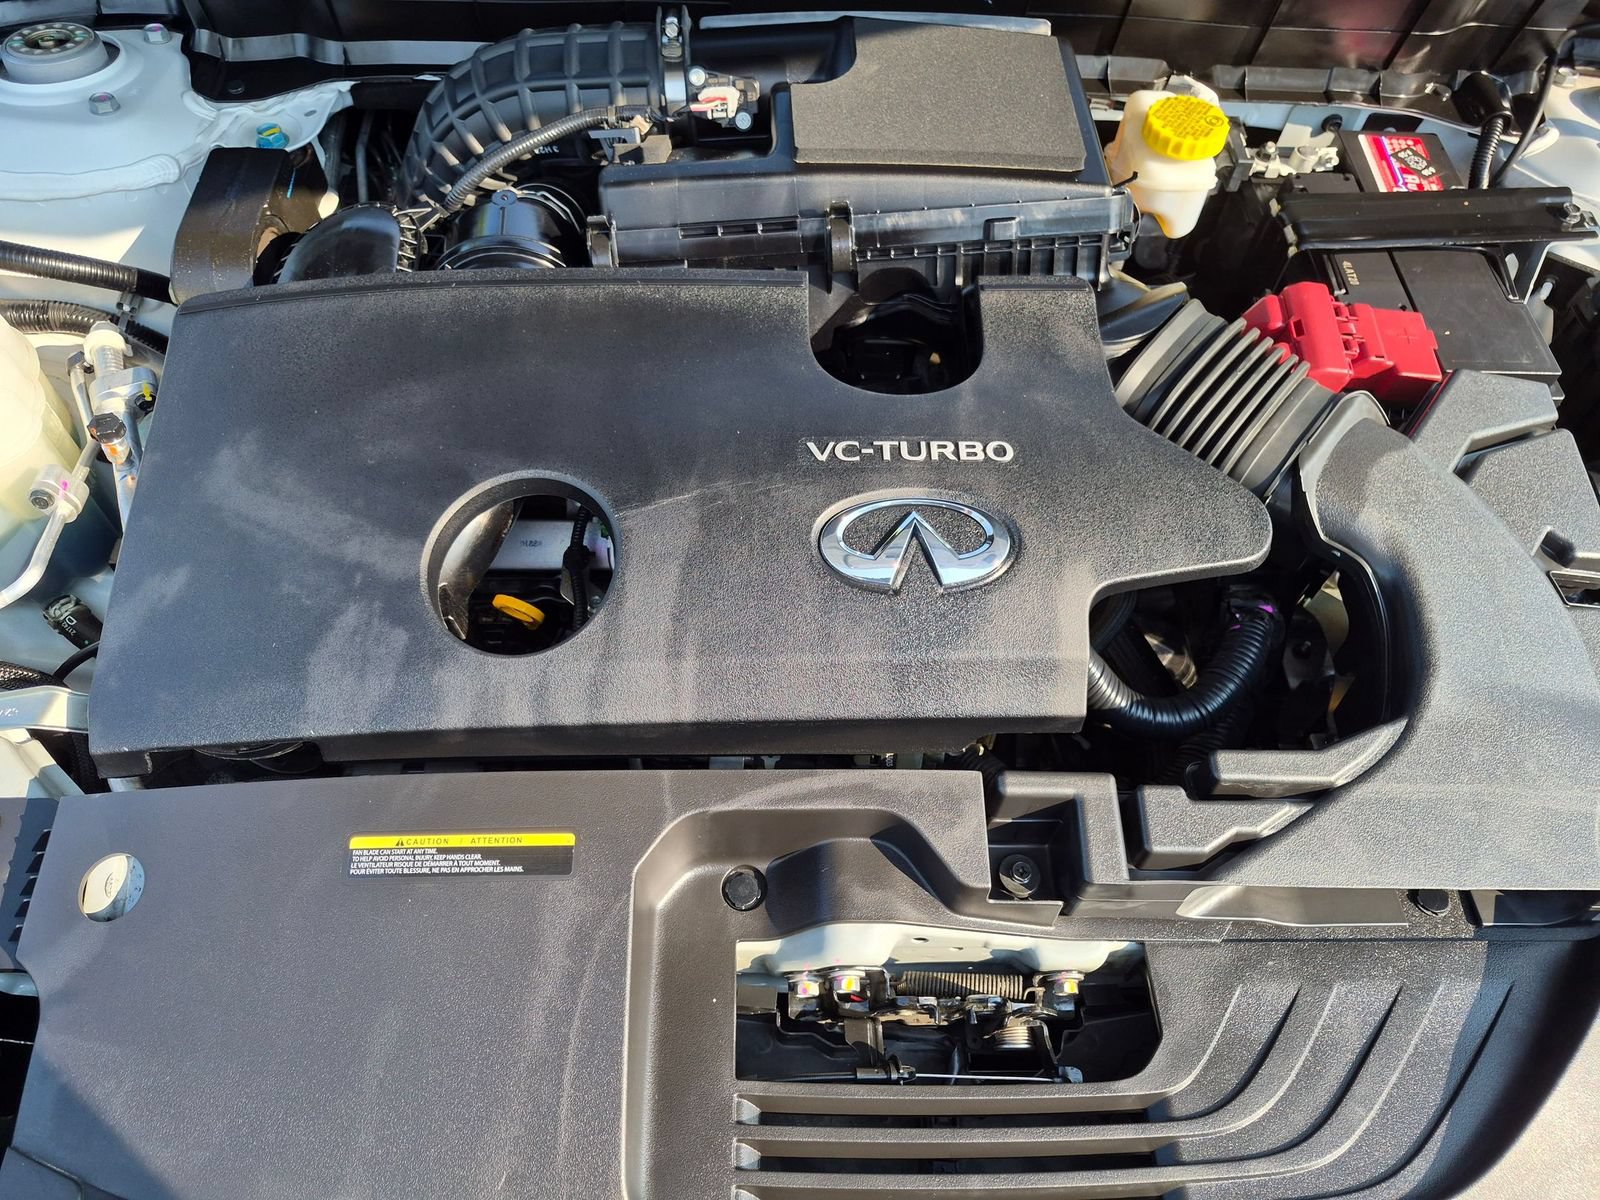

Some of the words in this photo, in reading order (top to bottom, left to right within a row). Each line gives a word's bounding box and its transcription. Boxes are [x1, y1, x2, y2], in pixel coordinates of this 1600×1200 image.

[806, 440, 1014, 463] VC-TURBO
[406, 838, 449, 846] CAUTION
[470, 836, 523, 844] ATTENTION
